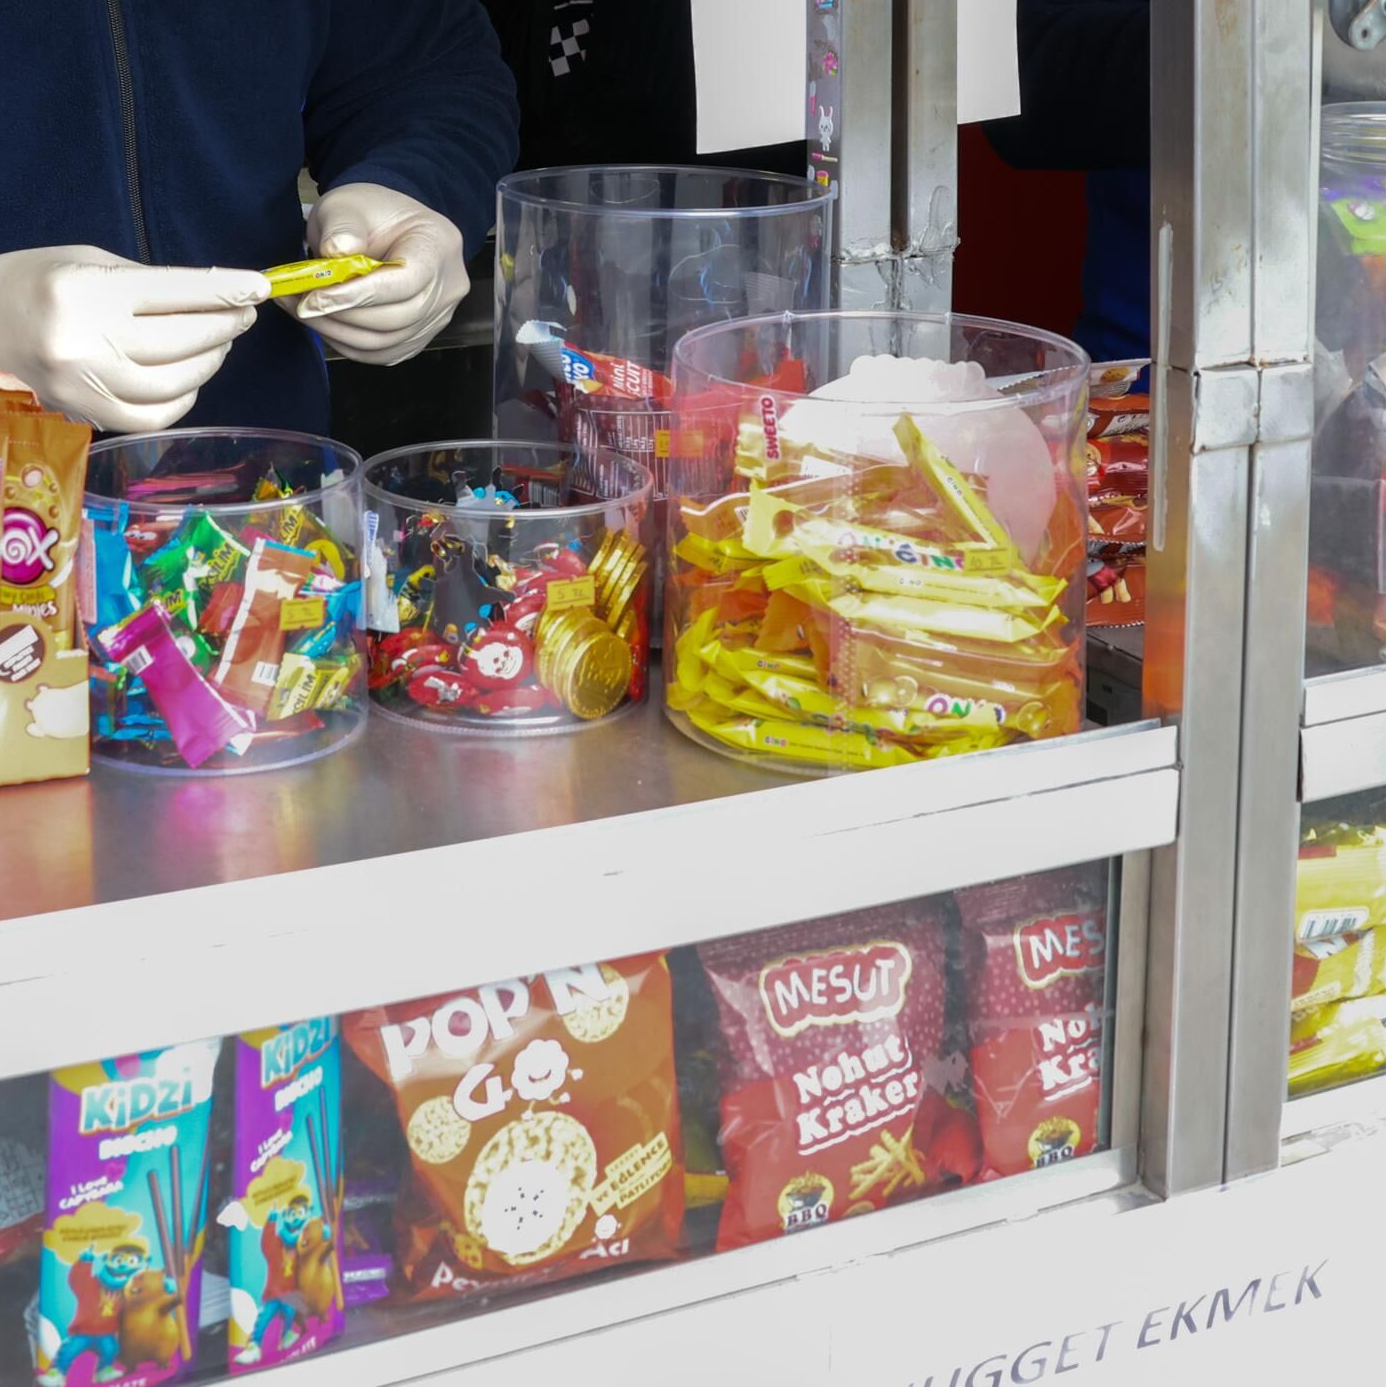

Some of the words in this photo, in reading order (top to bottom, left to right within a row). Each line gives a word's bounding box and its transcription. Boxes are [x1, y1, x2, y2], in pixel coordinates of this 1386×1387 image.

[758, 395, 782, 461] SWEETO
[773, 958, 897, 1016] MESUT
[793, 1033, 905, 1104] Nohut
[796, 1070, 919, 1147] Kraker
[786, 1202, 829, 1228] BBQ
[1136, 1257, 1329, 1350] EKMEK
